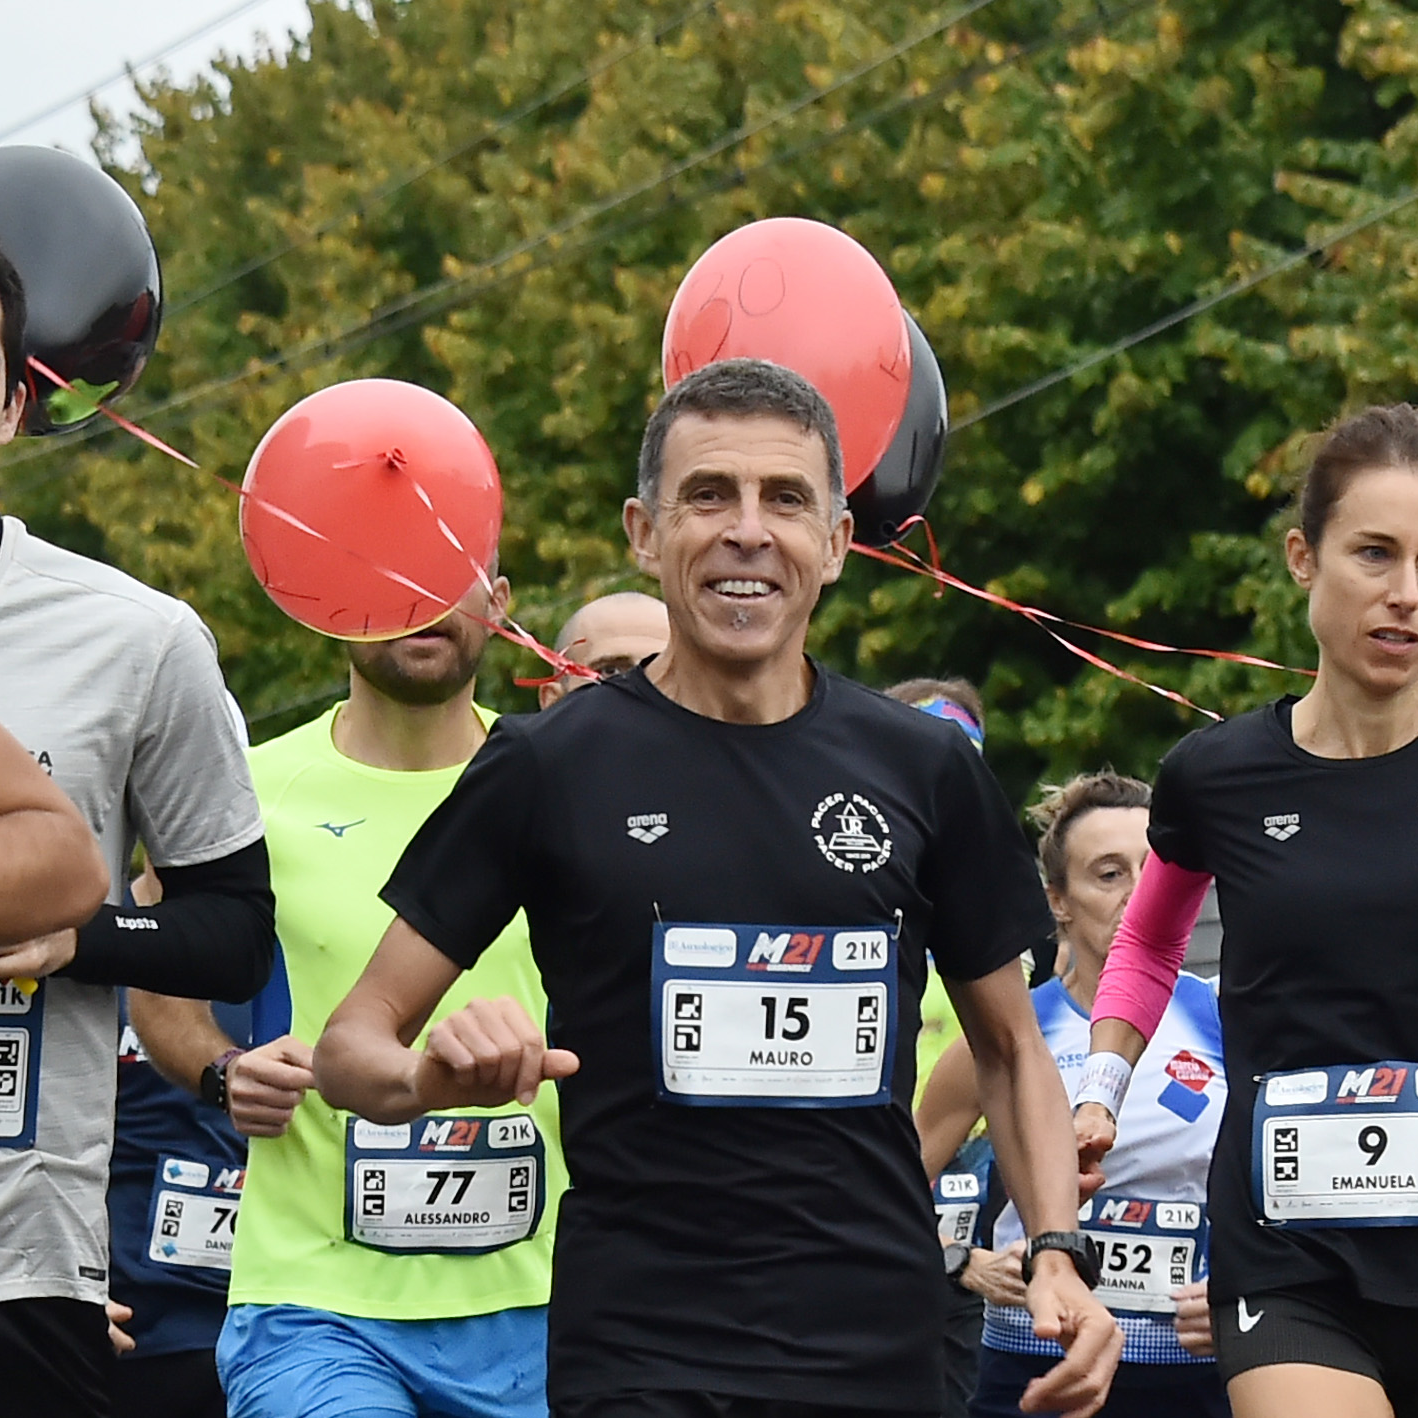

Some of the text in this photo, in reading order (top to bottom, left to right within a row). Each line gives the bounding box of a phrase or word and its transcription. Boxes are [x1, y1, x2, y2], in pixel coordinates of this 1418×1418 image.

[627, 813, 668, 828] arena
[811, 792, 845, 829] PACER
[1264, 813, 1300, 828] arena
[862, 839, 893, 873] PACER
[747, 932, 825, 964] M21
[845, 941, 882, 960] 21K
[761, 996, 811, 1041] 15
[749, 1051, 813, 1066] MAURO
[1337, 1066, 1408, 1097] M21
[420, 1120, 482, 1145] M21
[498, 1124, 531, 1141] 21K
[1358, 1125, 1389, 1166] 9
[425, 1170, 477, 1205] 77
[948, 1180, 974, 1192] 21K
[1331, 1174, 1417, 1191] EMANUELA
[404, 1211, 491, 1225] ALESSANDRO
[1164, 1209, 1196, 1223] 21K
[1094, 1239, 1152, 1274] 152
[1098, 1276, 1146, 1291] RIANNA
